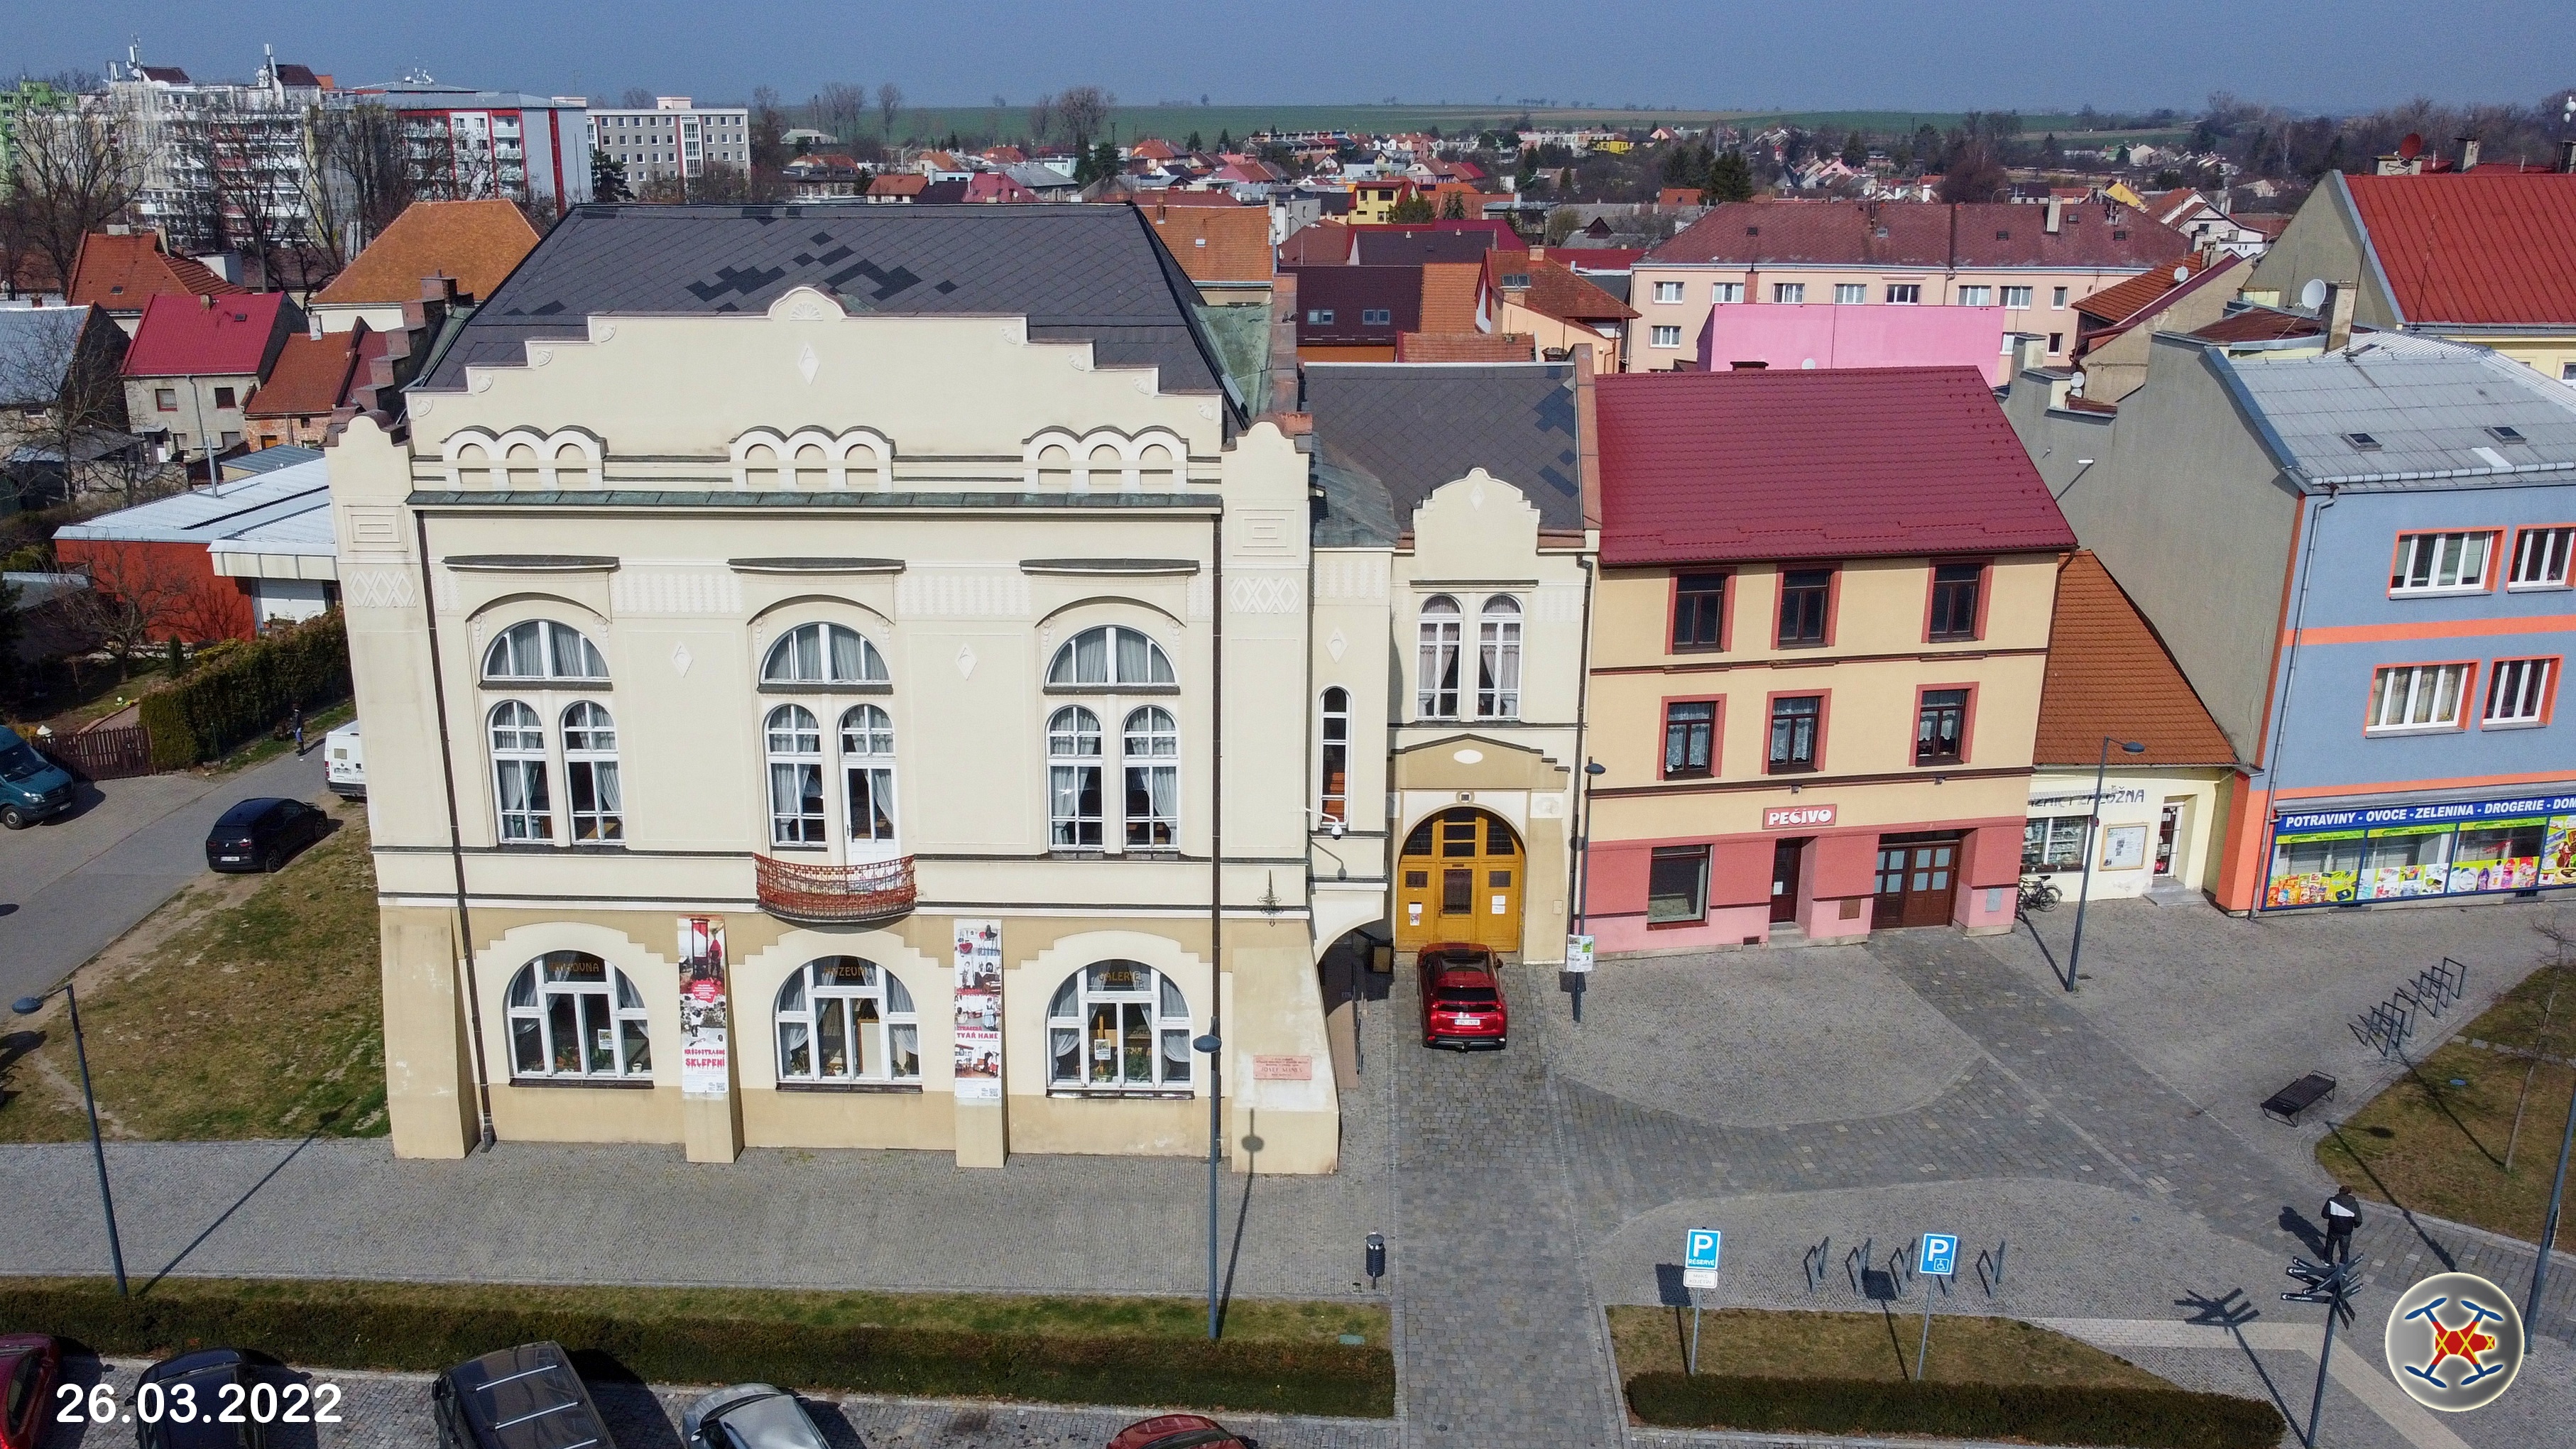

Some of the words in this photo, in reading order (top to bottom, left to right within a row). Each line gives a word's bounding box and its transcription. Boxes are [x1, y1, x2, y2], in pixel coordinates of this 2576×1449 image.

[2286, 812, 2356, 828] POTRAVINY
[2366, 809, 2407, 822] OVOCE
[2415, 804, 2474, 819] ZELENINA
[2484, 799, 2545, 814] DROGERIE
[1098, 970, 1142, 981] GALERIE
[1693, 1234, 1713, 1257] P
[1928, 1239, 1949, 1262] P
